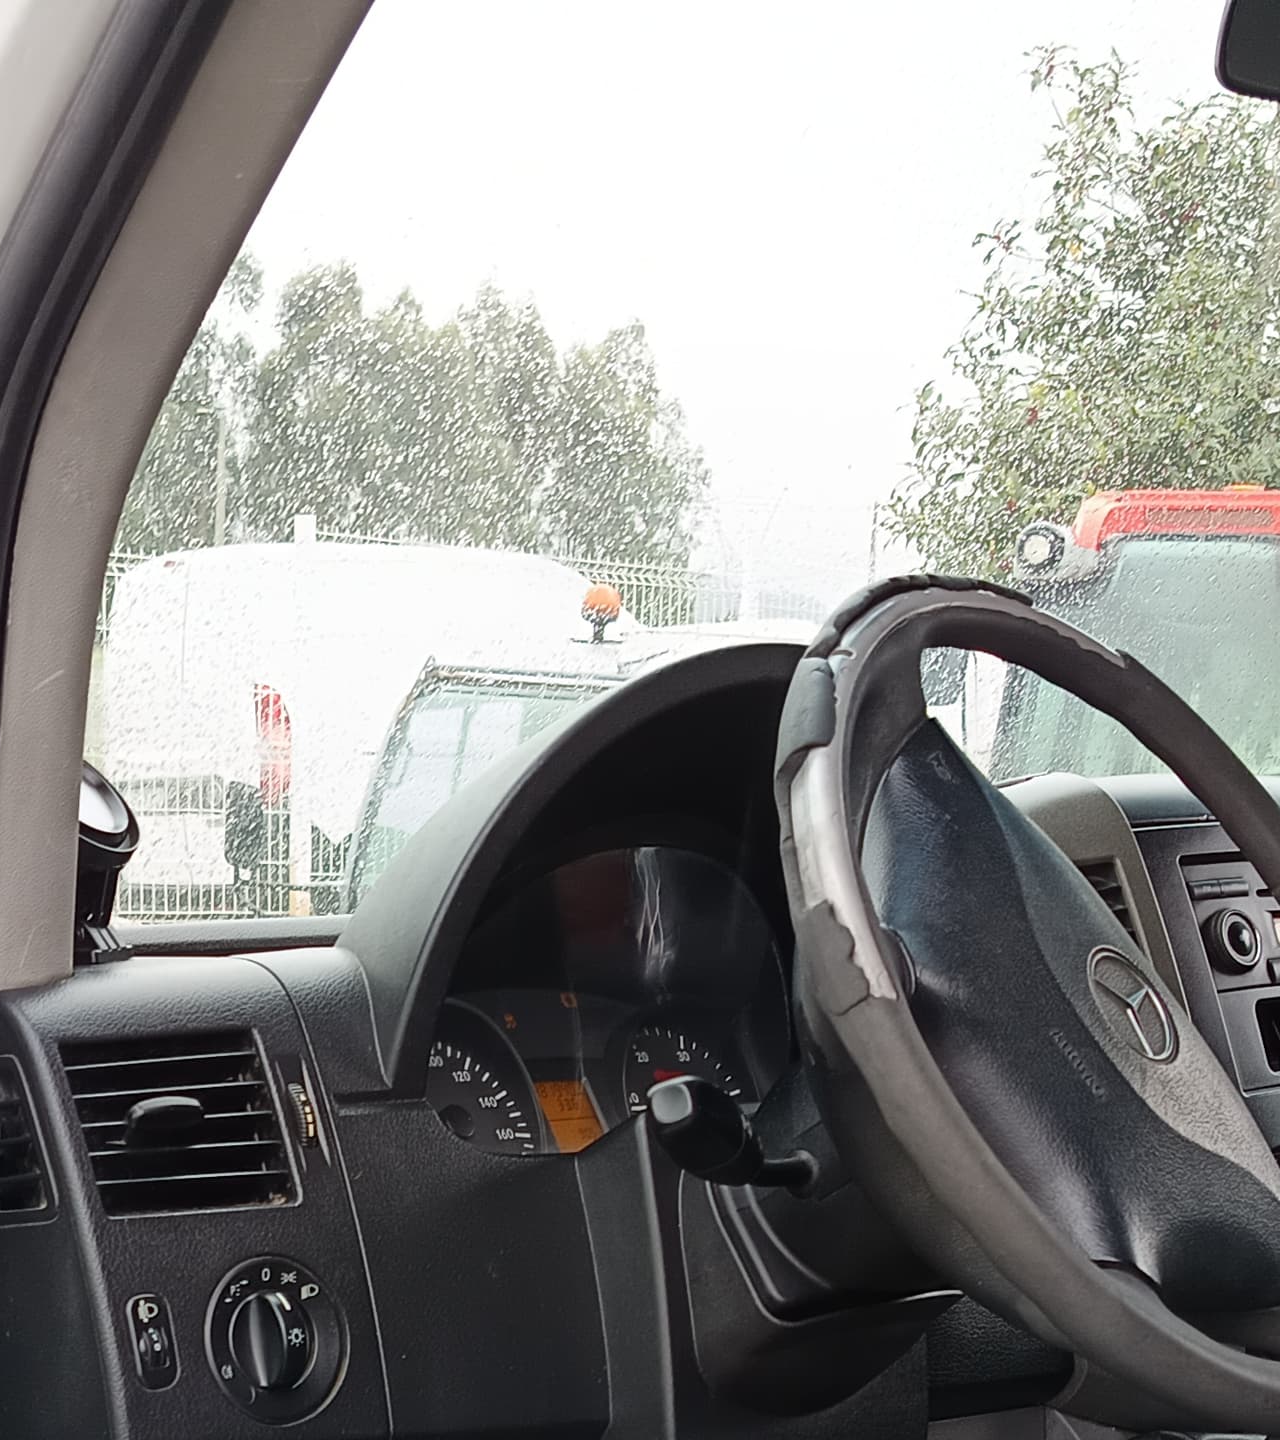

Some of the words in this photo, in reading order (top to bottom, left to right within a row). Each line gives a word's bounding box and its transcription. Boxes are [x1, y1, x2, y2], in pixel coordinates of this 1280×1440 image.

[428, 1056, 443, 1068] 00
[676, 1050, 690, 1062] 30
[452, 1070, 471, 1082] 120
[478, 1096, 498, 1109] 140
[495, 1128, 514, 1140] 160
